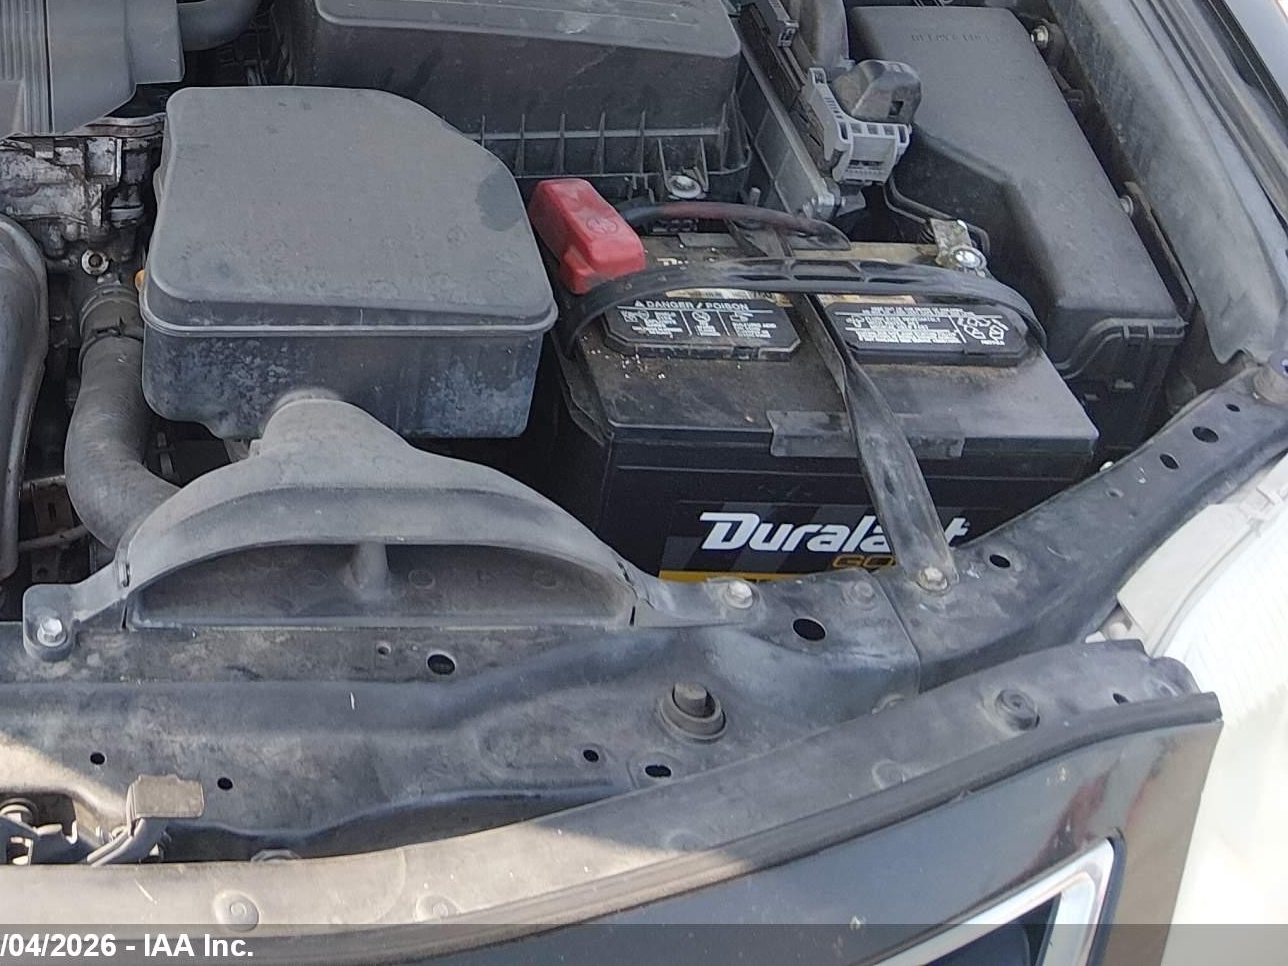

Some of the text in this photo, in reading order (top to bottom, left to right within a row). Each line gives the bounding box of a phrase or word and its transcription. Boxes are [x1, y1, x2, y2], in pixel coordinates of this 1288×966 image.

[645, 299, 694, 310] DANGER
[705, 302, 750, 311] POISON
[699, 512, 970, 553] Duralat
[832, 554, 896, 570] GO
